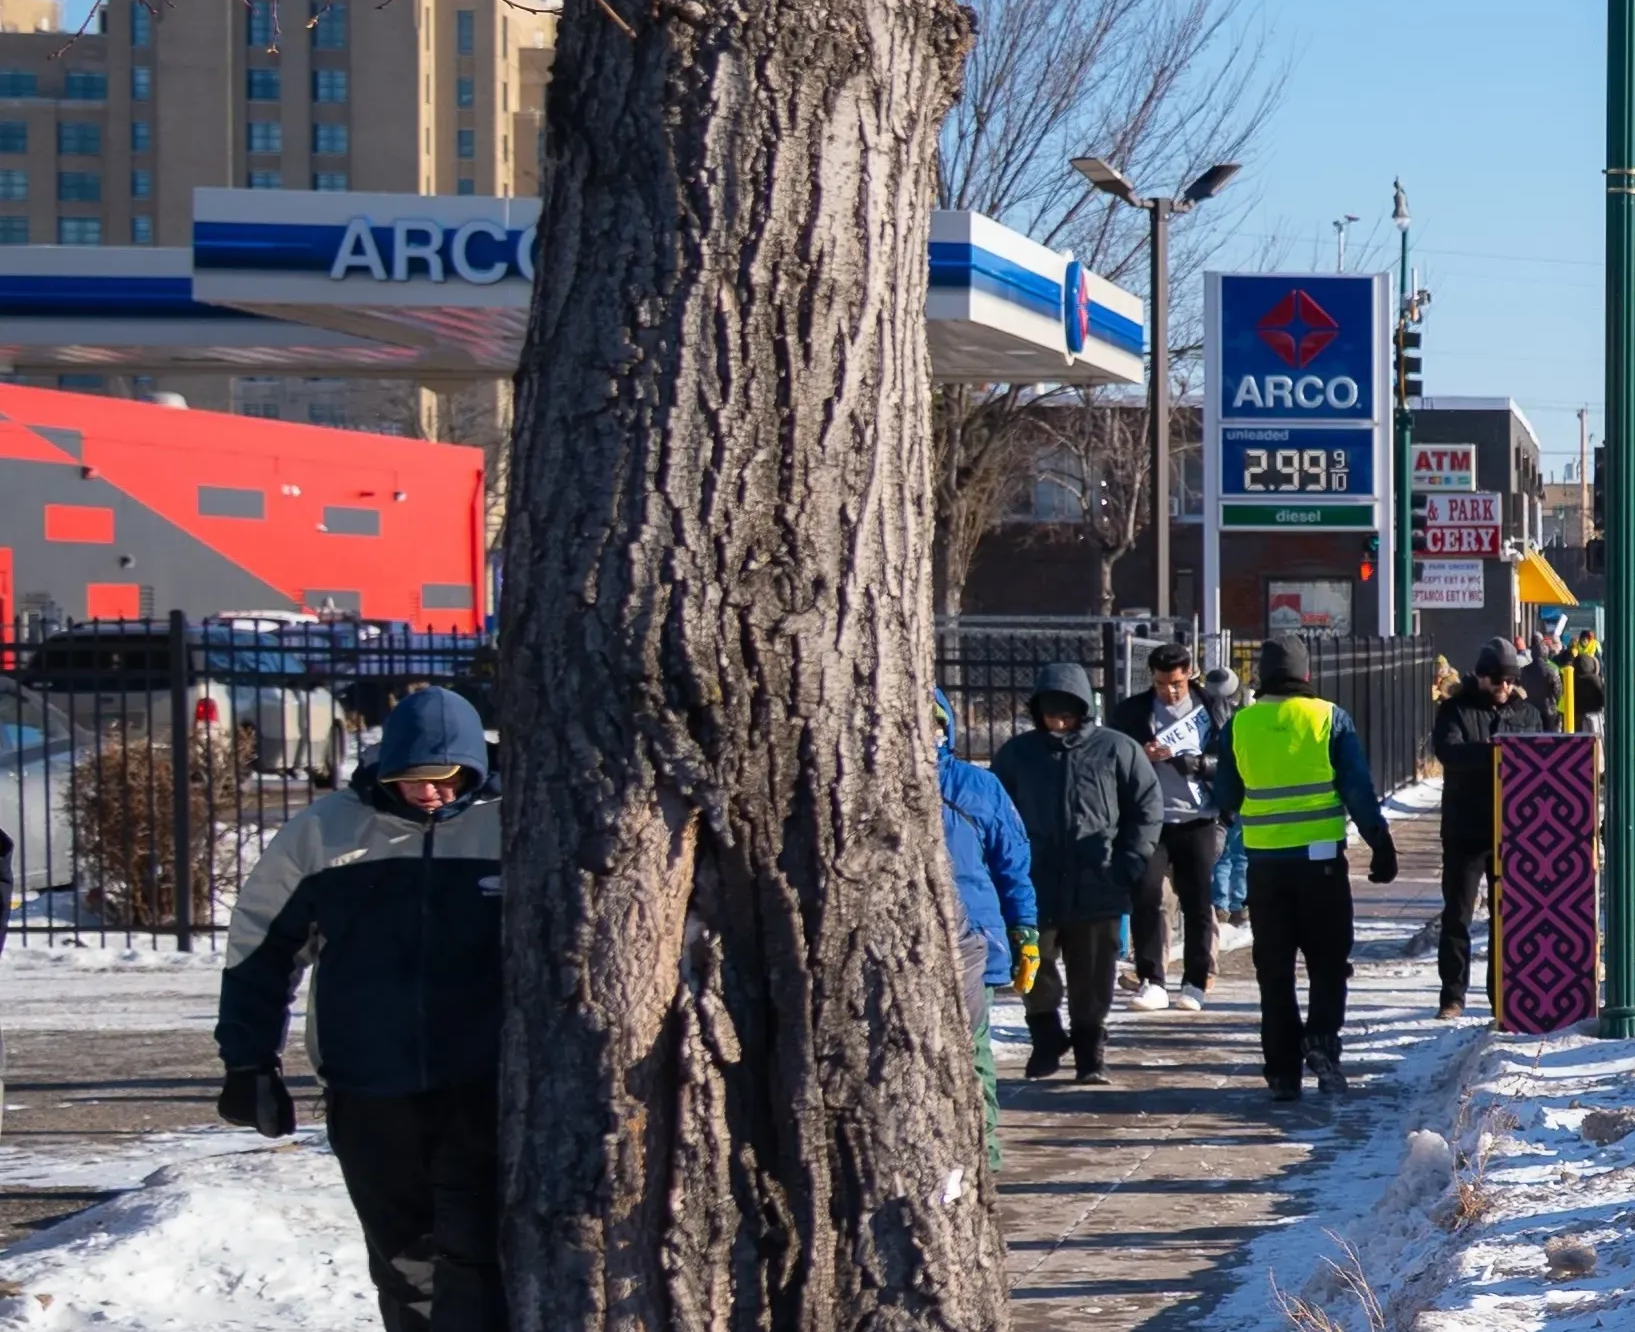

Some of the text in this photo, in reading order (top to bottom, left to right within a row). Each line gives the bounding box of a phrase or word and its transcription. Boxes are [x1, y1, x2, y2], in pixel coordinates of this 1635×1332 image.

[1232, 374, 1360, 409] ARCO
[1226, 429, 1289, 441] unleaded
[1244, 449, 1327, 491] 2.99
[1414, 451, 1471, 472] ATM
[1275, 510, 1321, 522] diesel
[1448, 499, 1495, 521] PARK
[1424, 528, 1495, 552] CERY
[1162, 710, 1209, 745] WE ARE
